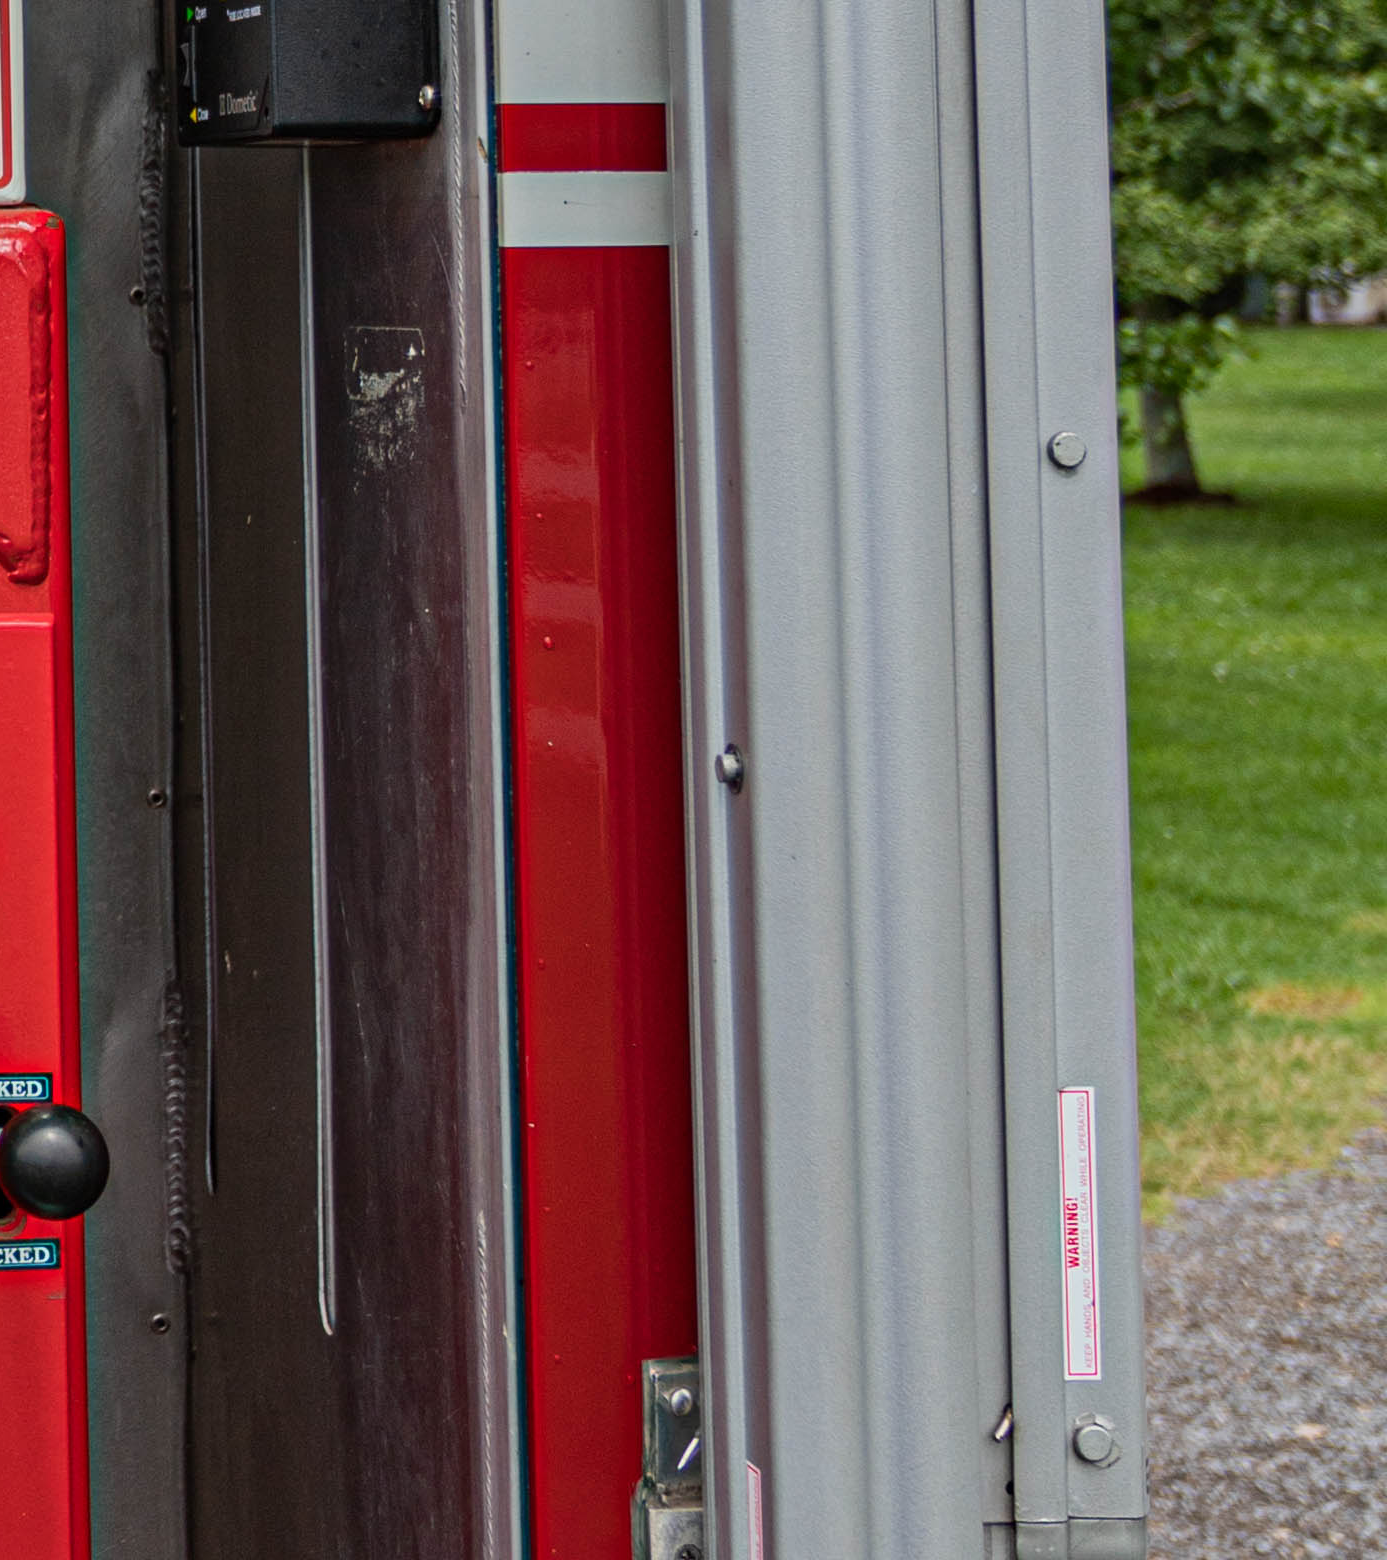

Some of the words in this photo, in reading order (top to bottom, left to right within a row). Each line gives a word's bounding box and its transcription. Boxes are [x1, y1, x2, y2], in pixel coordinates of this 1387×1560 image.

[1076, 1096, 1086, 1151] OPERATING
[1078, 1157, 1088, 1187] WHILE
[1080, 1192, 1089, 1223] CLEAR
[1066, 1197, 1080, 1268] WARNING!
[1081, 1229, 1091, 1273] OBJECTS
[1082, 1279, 1091, 1299] AND
[1083, 1304, 1092, 1338] HANDS
[1084, 1343, 1093, 1368] KEEP
